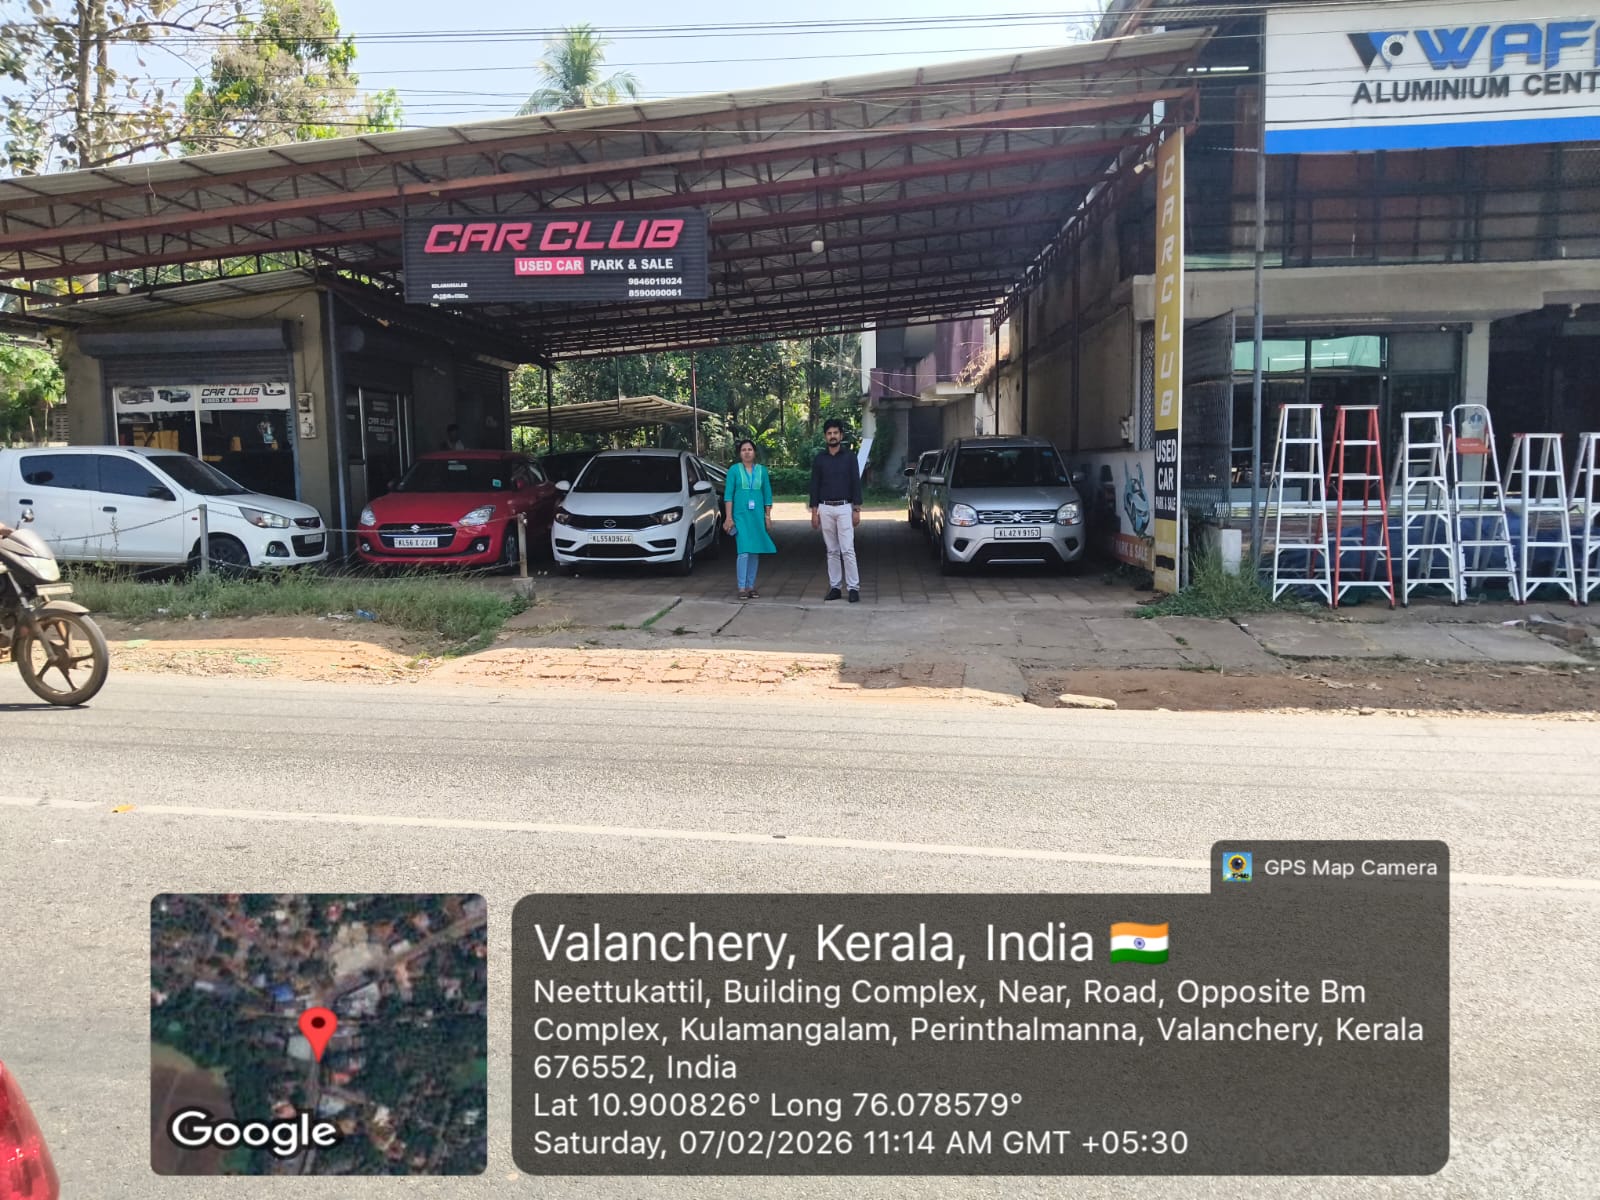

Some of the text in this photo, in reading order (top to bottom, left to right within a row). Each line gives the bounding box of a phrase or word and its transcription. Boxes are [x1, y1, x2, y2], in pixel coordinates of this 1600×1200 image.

[1413, 20, 1600, 73] WAF
[1352, 76, 1510, 104] ALUMINIUM
[423, 218, 685, 254] CAR CLUB
[518, 258, 674, 272] USED CAR PARK & SALE
[201, 387, 260, 397] CAR CLUB
[1155, 438, 1177, 463] USED
[1158, 467, 1174, 491] CAR
